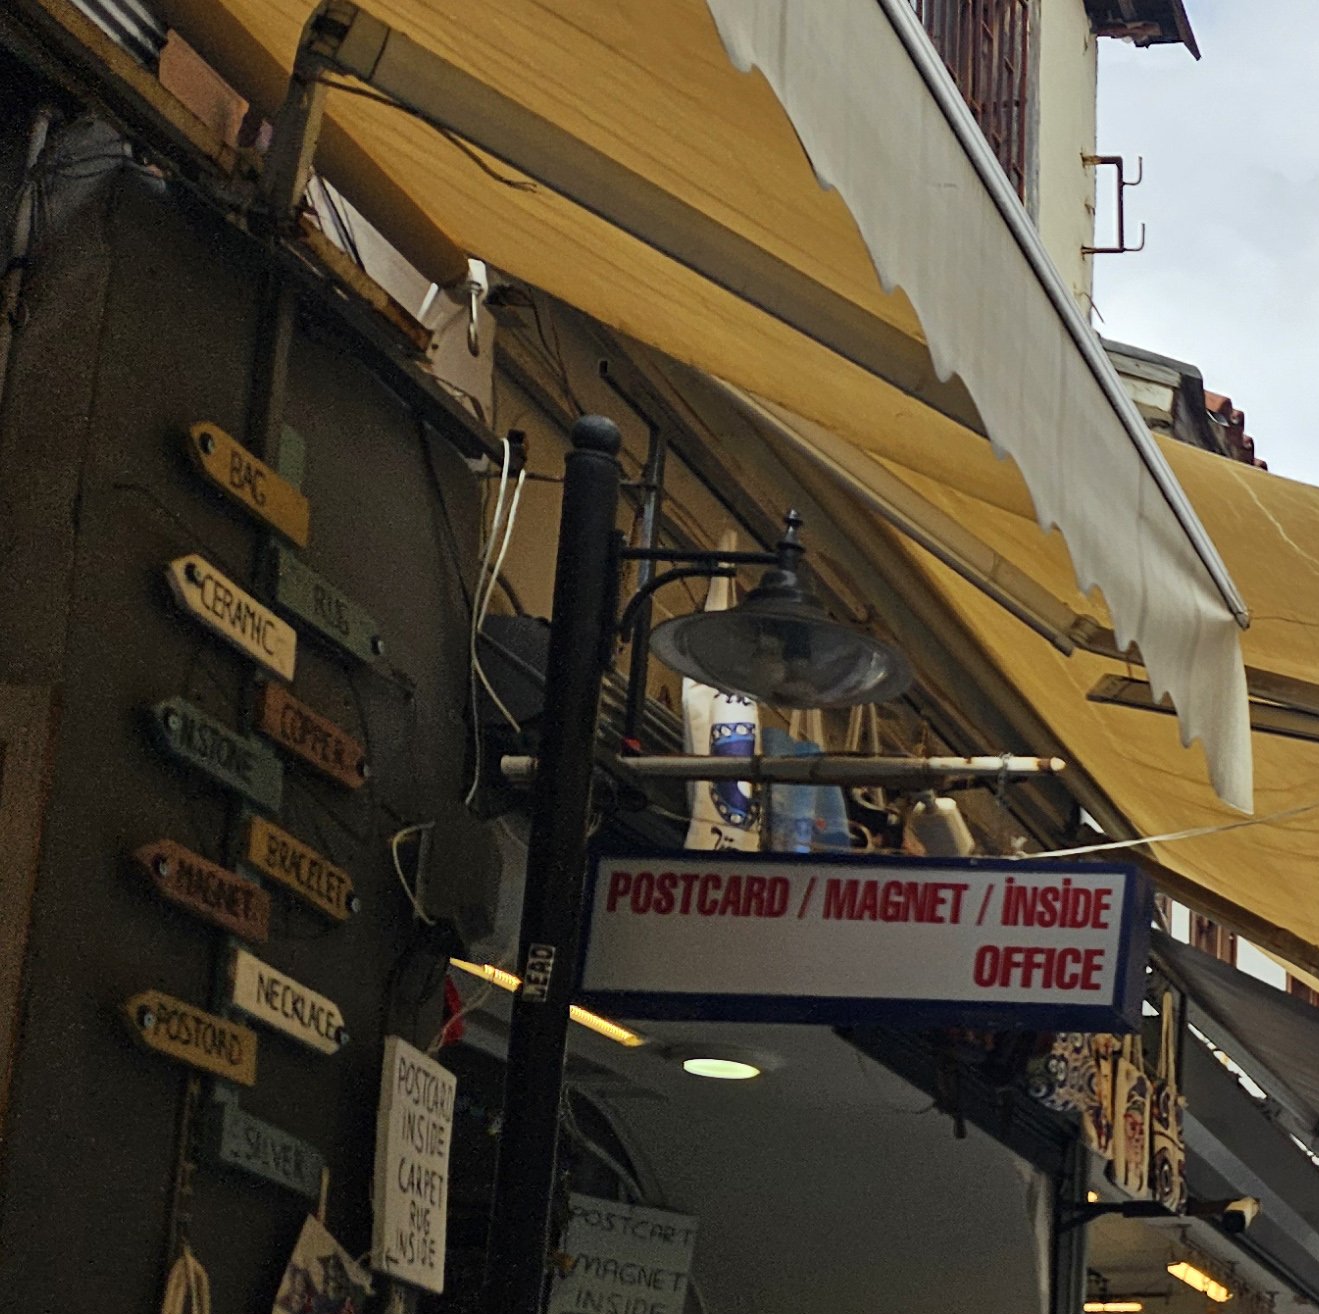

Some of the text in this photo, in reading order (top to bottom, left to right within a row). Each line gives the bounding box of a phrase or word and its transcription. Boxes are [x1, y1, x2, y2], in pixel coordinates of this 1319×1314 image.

[228, 449, 267, 507] BAG
[198, 574, 277, 656] CERAMIC
[266, 833, 346, 911] BRACELET
[606, 870, 790, 920] POSTCARD
[822, 877, 970, 926] MAGNET
[973, 944, 1106, 991] OFFICE
[153, 1002, 243, 1066] POSTCARD
[256, 972, 337, 1041] NECKLACE
[397, 1056, 454, 1123] POSTCARD
[401, 1107, 446, 1158] INSIDE
[397, 1156, 444, 1209] CARPET
[409, 1198, 431, 1236] RUG
[395, 1229, 437, 1269] INSIDE
[576, 1252, 688, 1293] MAGNET
